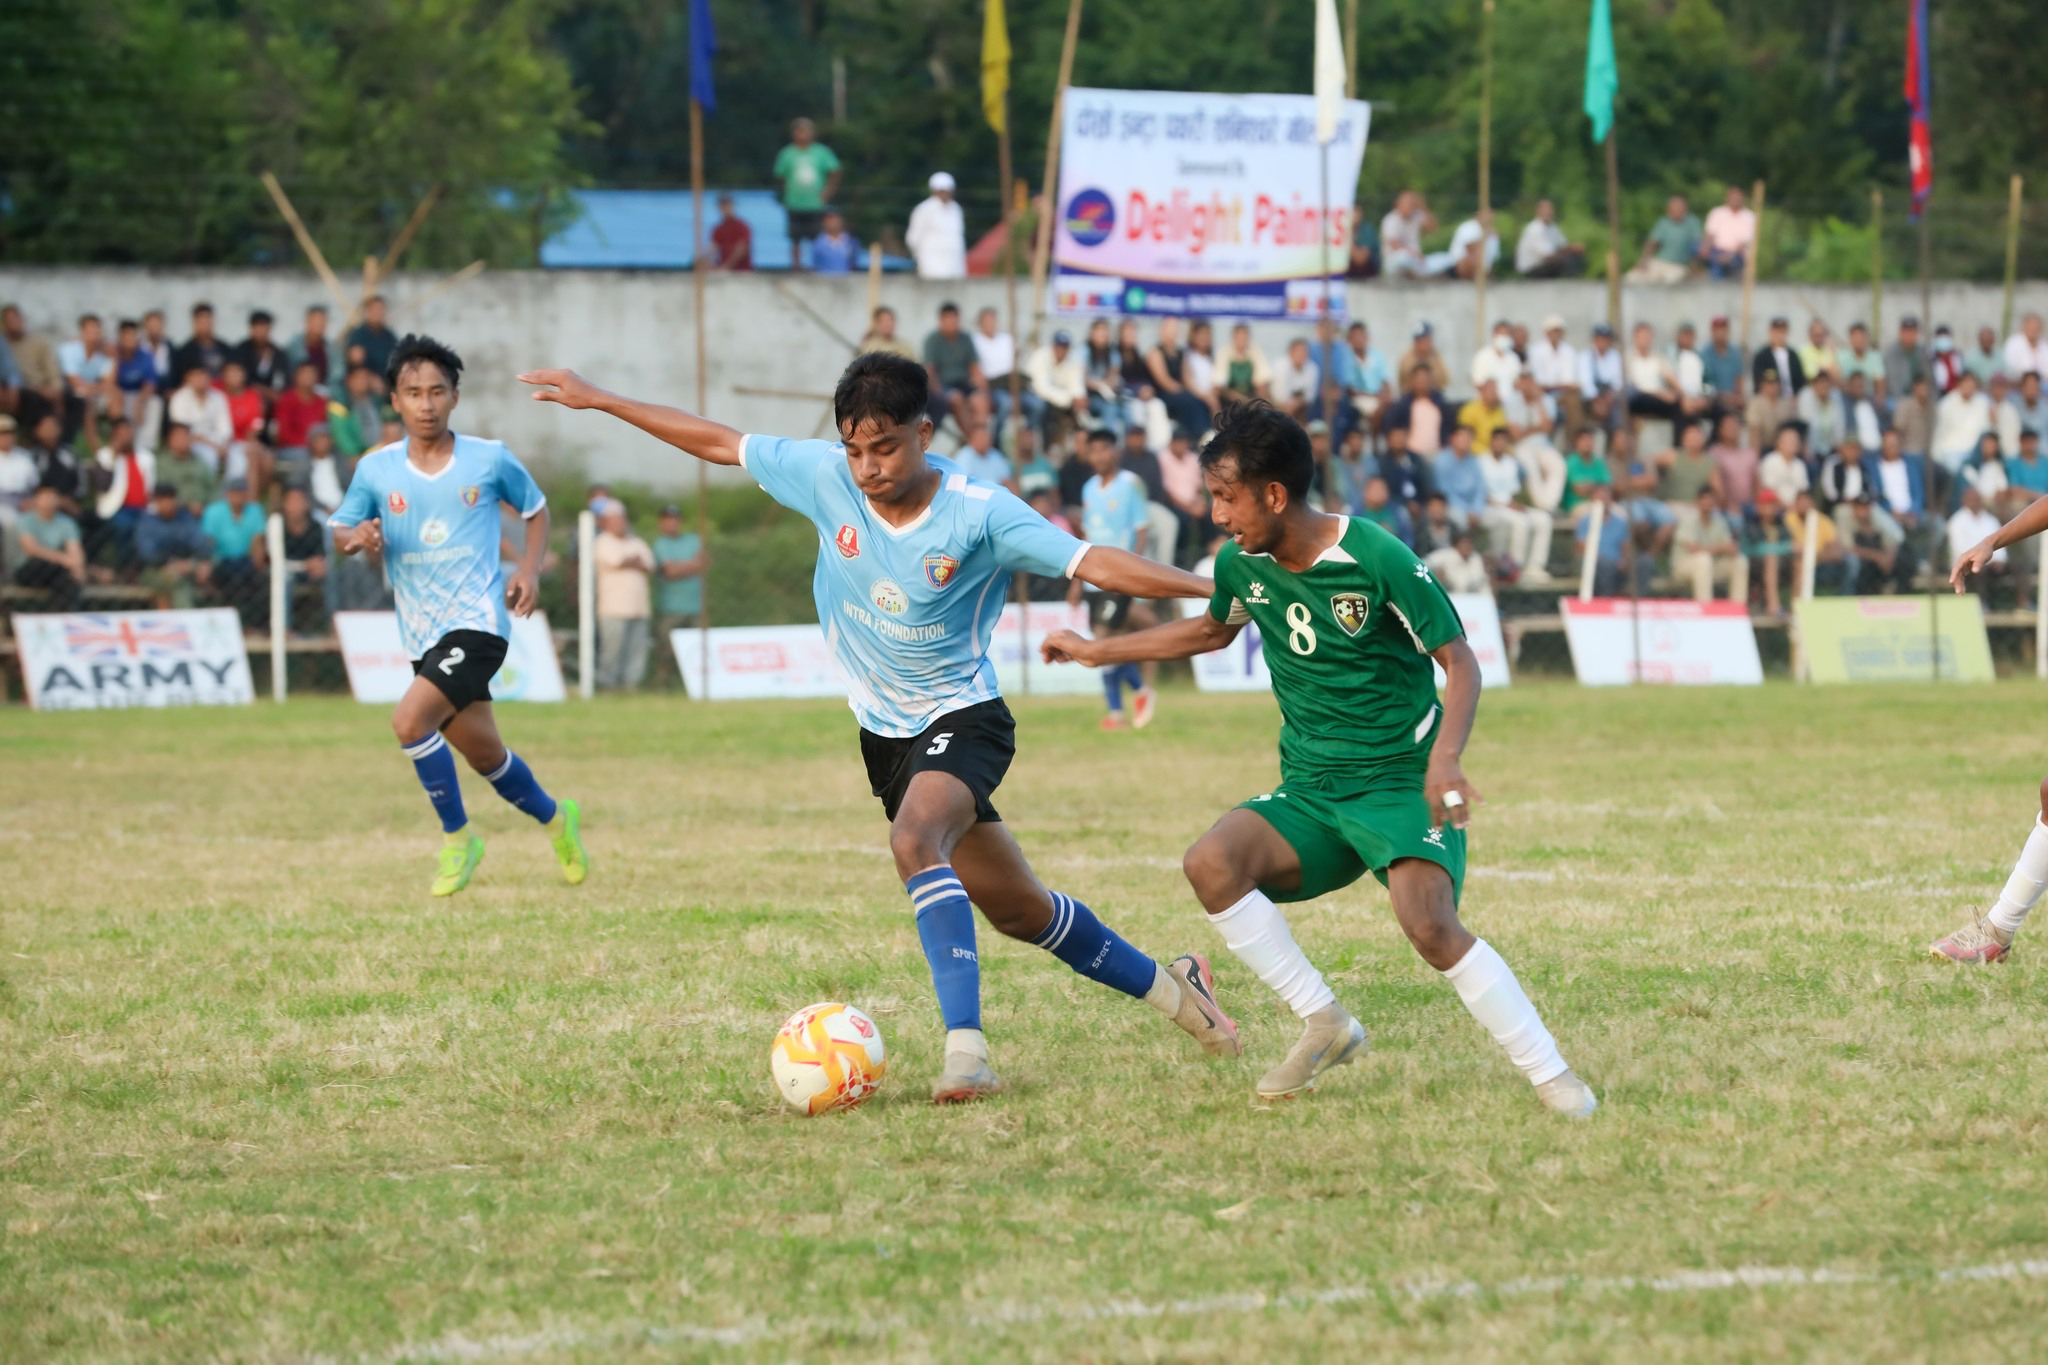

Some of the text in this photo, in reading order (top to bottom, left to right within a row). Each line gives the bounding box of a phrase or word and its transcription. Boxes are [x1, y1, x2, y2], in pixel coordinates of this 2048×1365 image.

[1127, 188, 1243, 254] Delight
[843, 599, 945, 641] INTRA FOUNDATION
[1286, 602, 1317, 656] 8
[42, 658, 235, 692] ARMY
[438, 647, 466, 676] 2
[926, 733, 953, 756] 5
